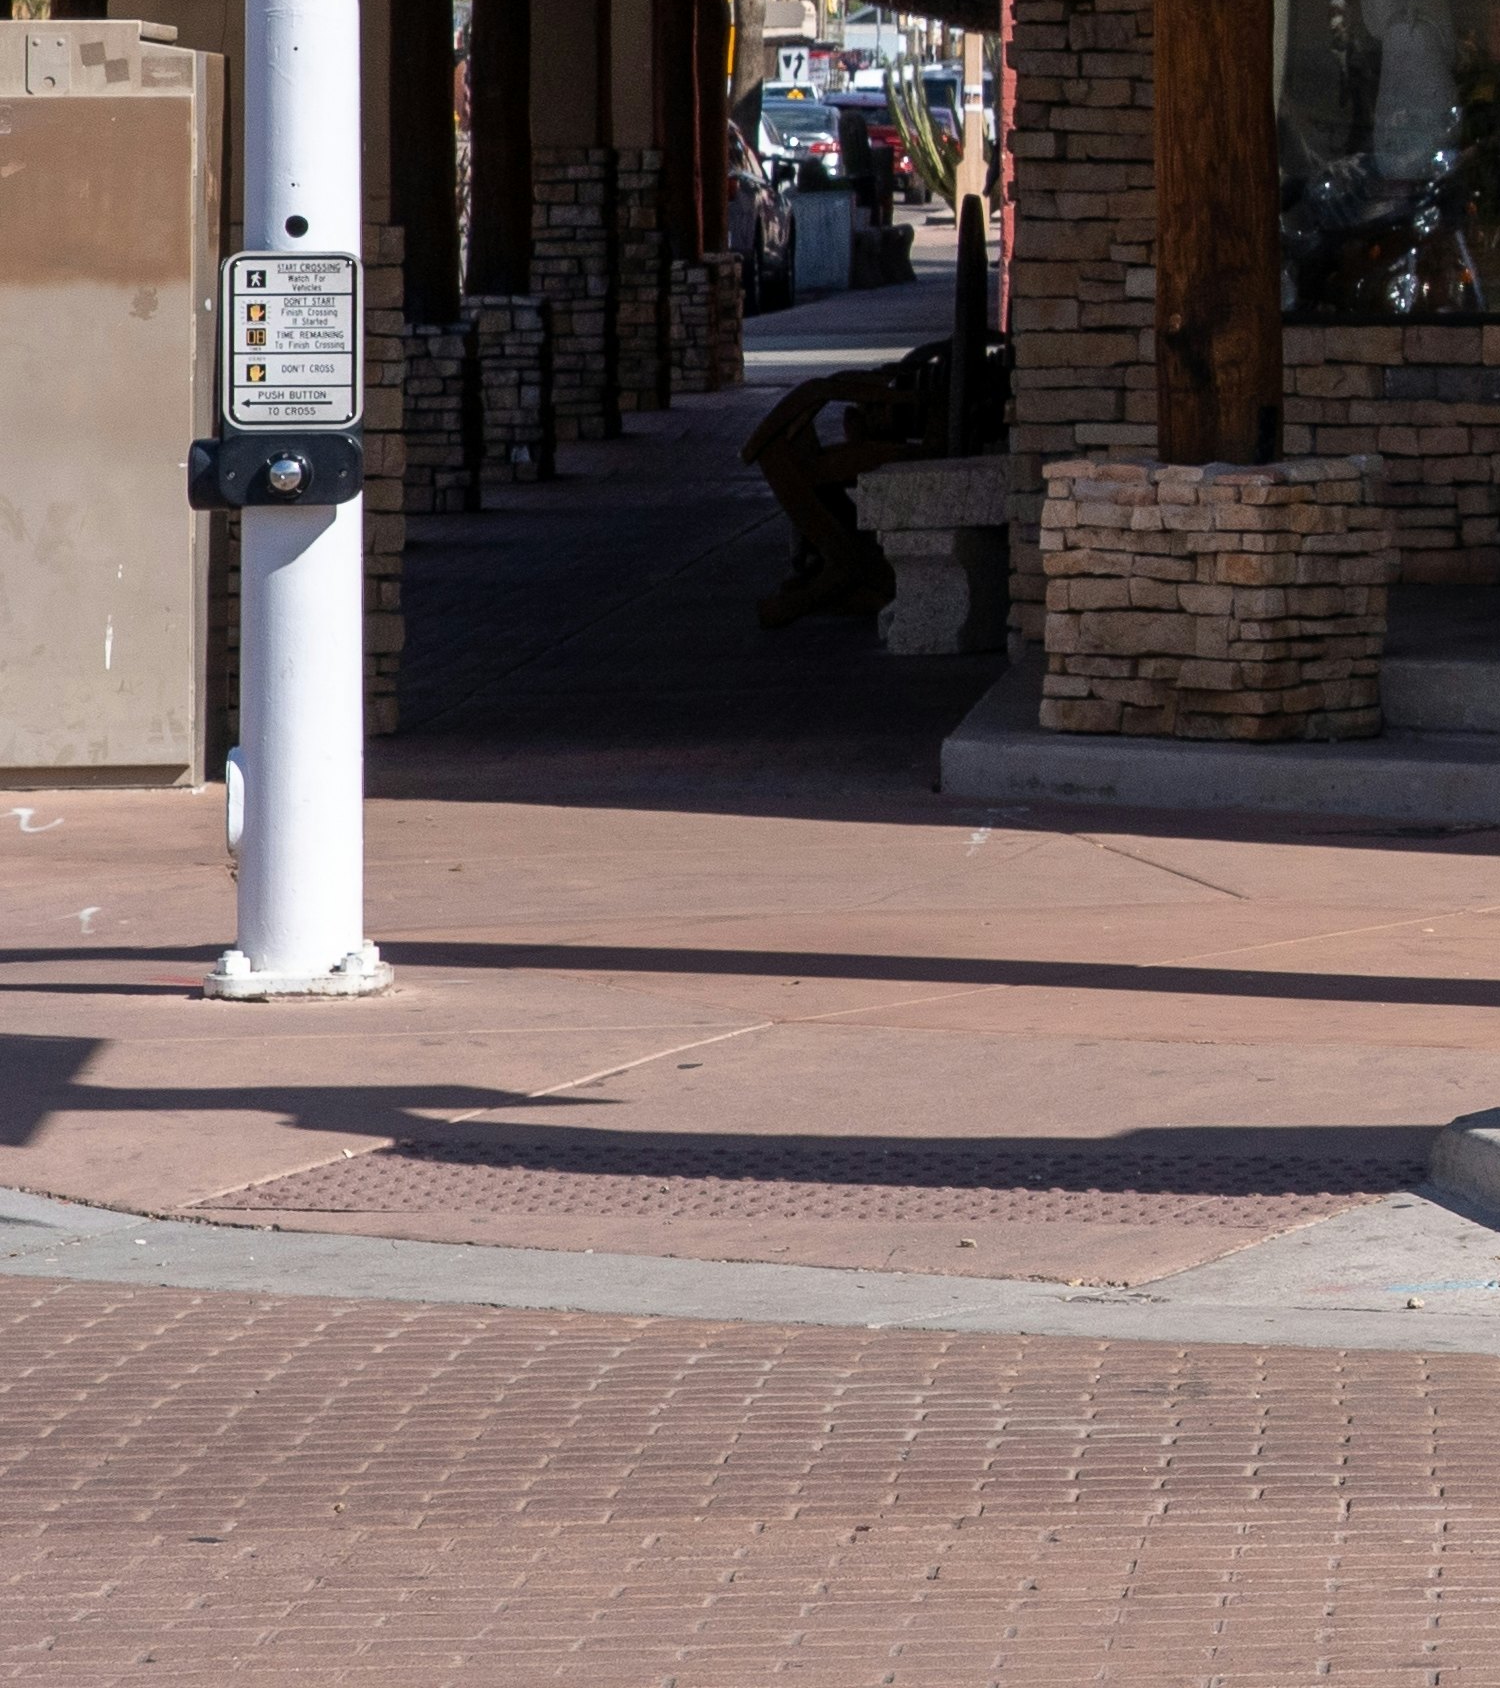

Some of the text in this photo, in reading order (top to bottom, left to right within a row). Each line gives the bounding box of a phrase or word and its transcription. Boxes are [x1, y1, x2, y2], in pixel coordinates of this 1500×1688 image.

[277, 263, 341, 272] START CROSSING
[292, 283, 322, 292] Vehicles
[283, 297, 335, 306] DON'T START
[281, 308, 338, 318] Finish Crossing
[302, 318, 328, 326] Started
[277, 331, 344, 339] TIME REMAINING
[275, 341, 345, 350] To Finish Crossing
[281, 364, 335, 373] DON'T CROSS
[258, 391, 327, 400] PUSH BUTTON
[268, 407, 317, 416] TO CROSS
